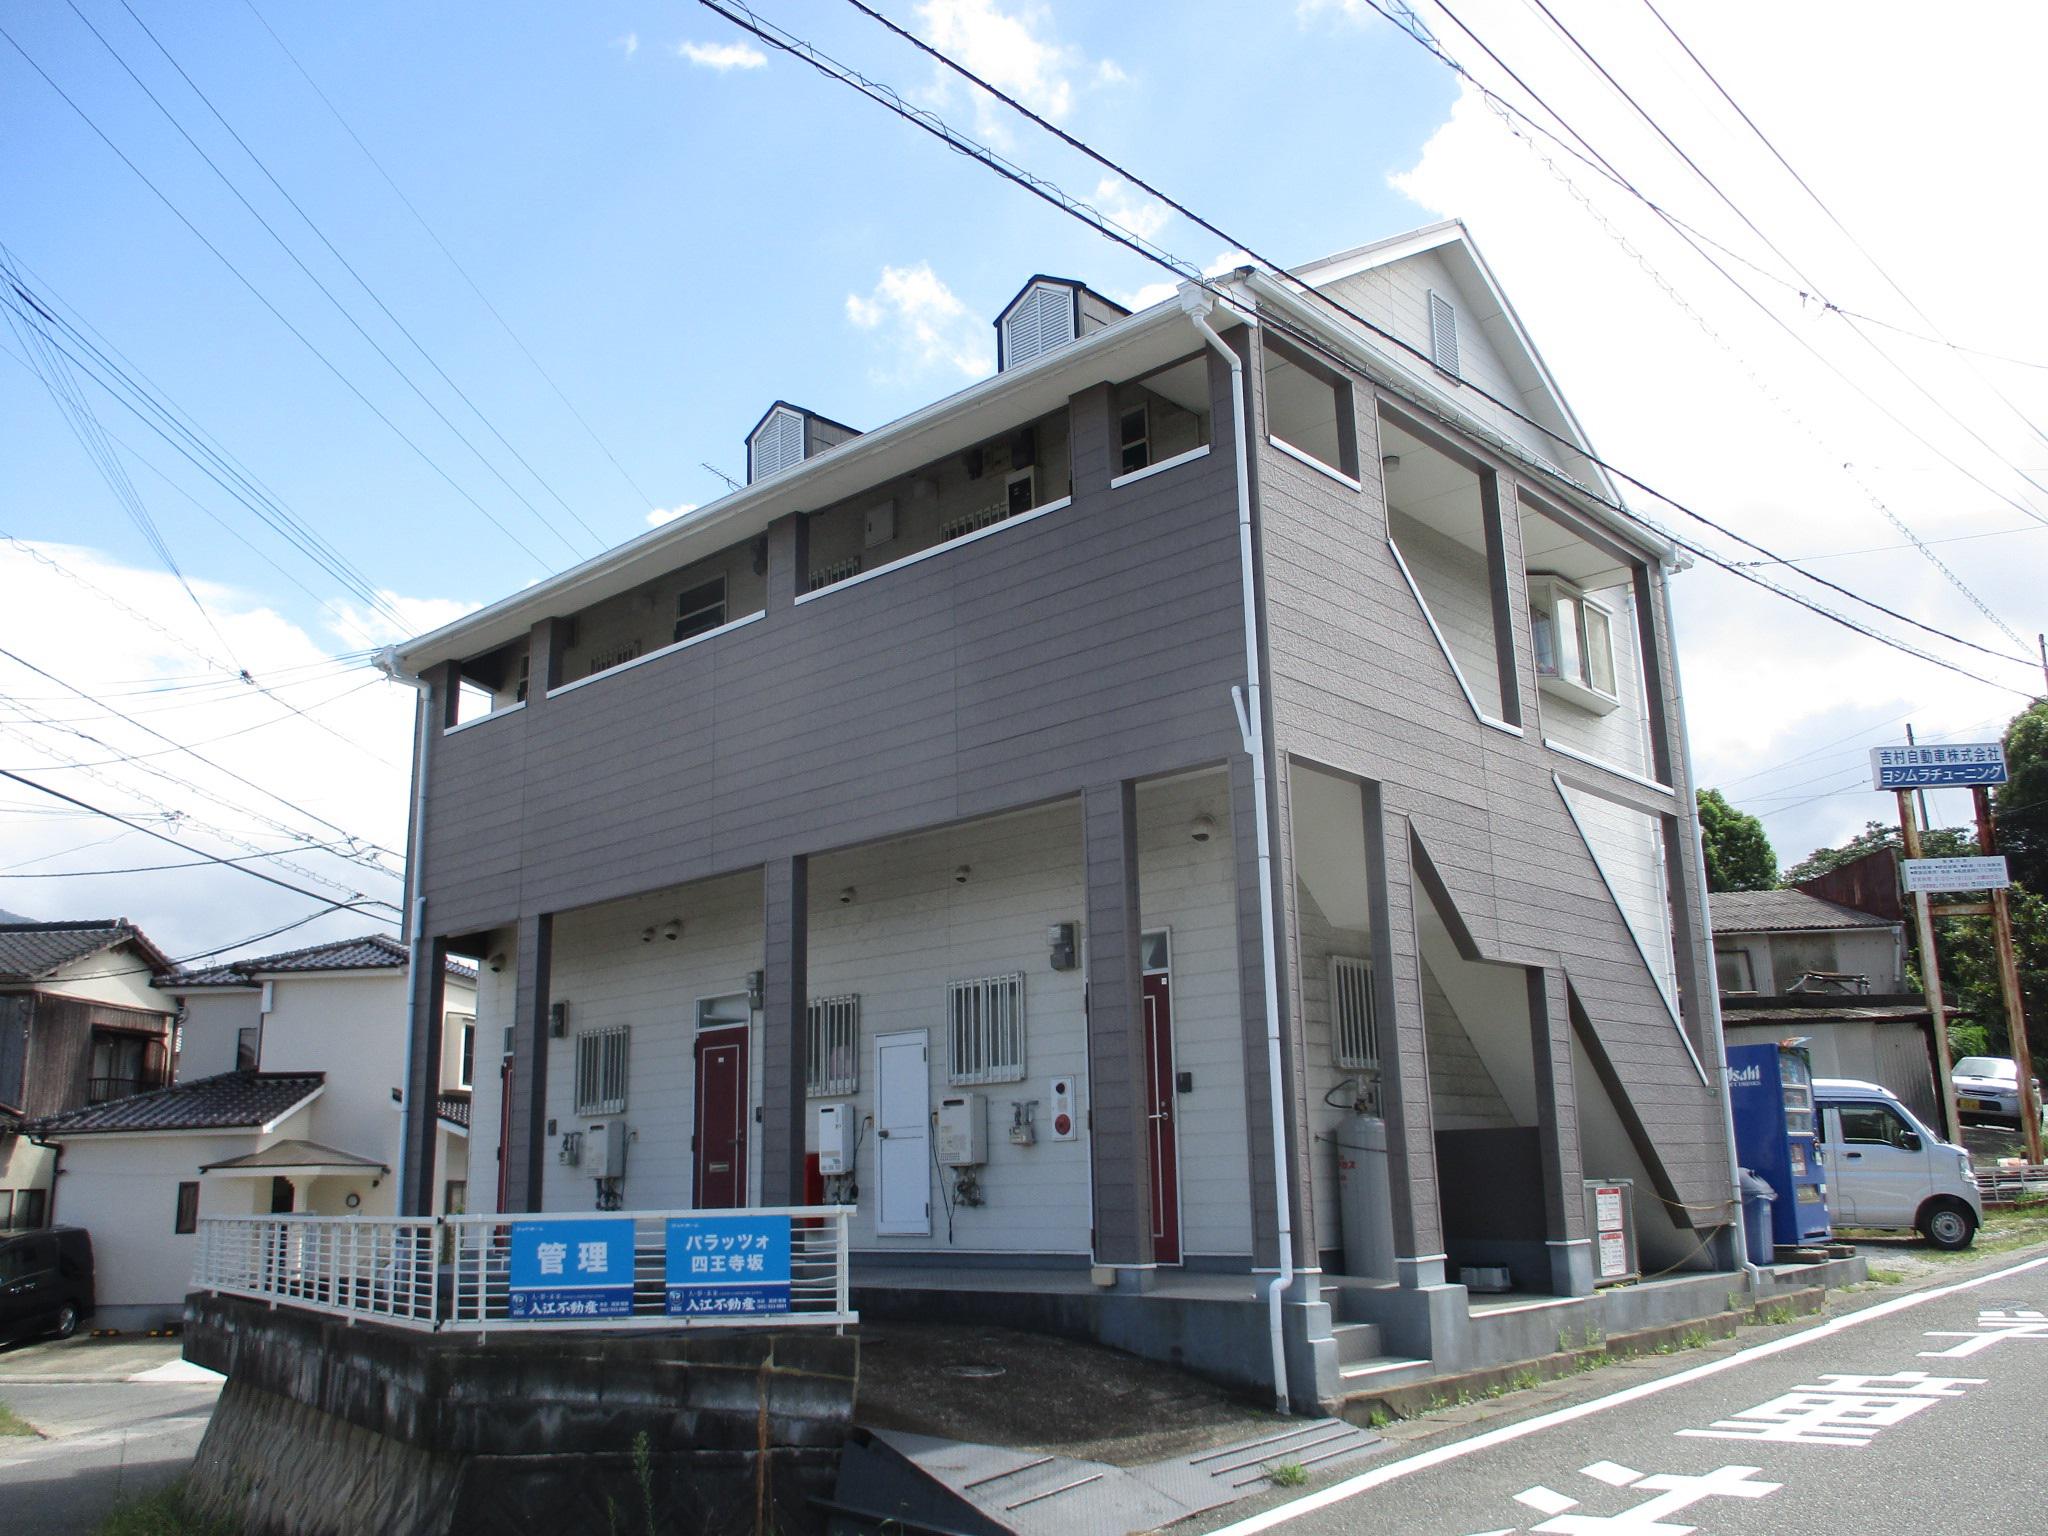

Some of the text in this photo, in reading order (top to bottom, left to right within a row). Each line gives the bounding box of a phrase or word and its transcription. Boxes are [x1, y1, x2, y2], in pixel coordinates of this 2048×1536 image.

[1880, 747, 2000, 765] 吉村自動車株式会社
[1882, 765, 2002, 783] ヨシムラチューニング
[537, 1242, 608, 1275] 管理
[691, 1254, 764, 1273] 四王寺坂
[529, 1300, 598, 1315] 入江不動産
[686, 1297, 756, 1312] 入江不動産
